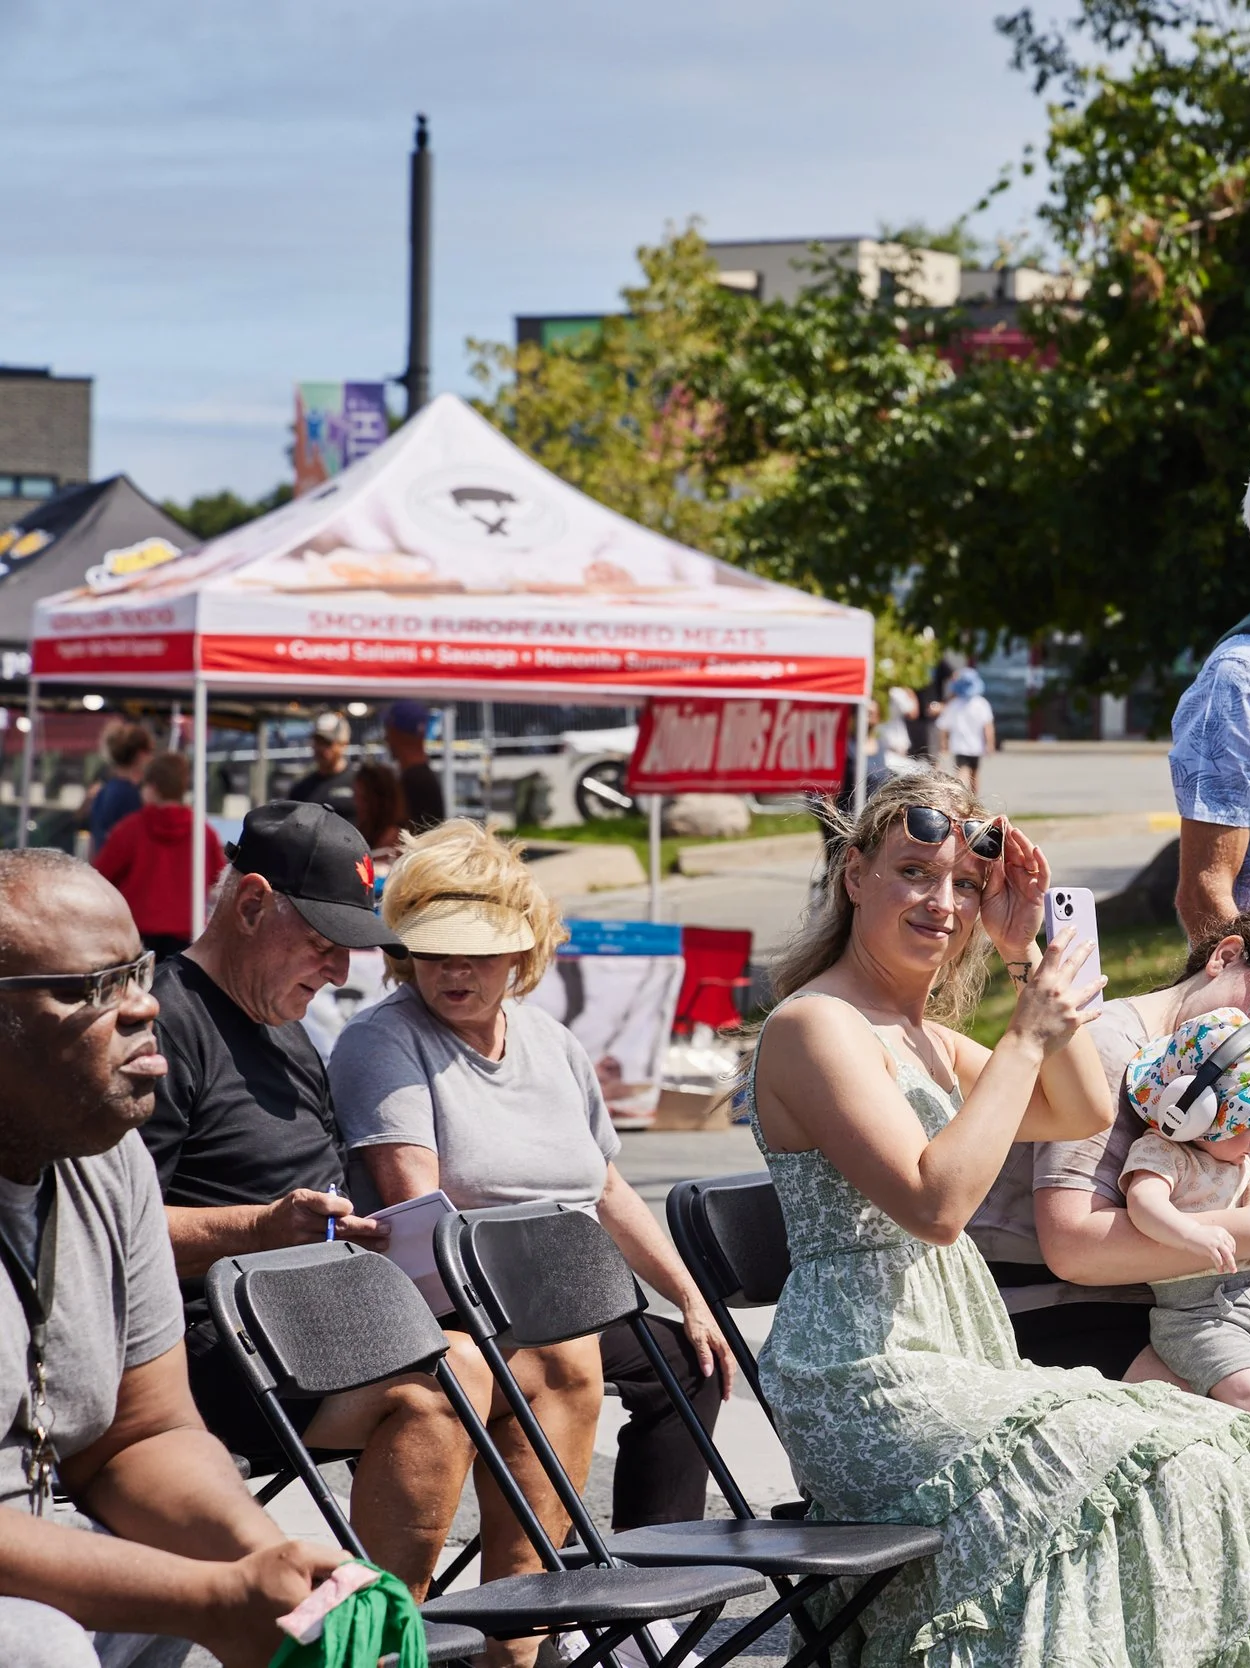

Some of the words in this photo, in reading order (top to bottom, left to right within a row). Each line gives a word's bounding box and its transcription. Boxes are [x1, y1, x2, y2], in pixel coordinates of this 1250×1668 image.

[308, 611, 421, 634] SMOKED
[430, 616, 577, 638] EUROPEAN
[584, 622, 674, 644] CURED
[684, 626, 768, 649] MEATS
[289, 639, 349, 661] Cured
[353, 640, 417, 663] Salami
[437, 644, 518, 669] Sausage
